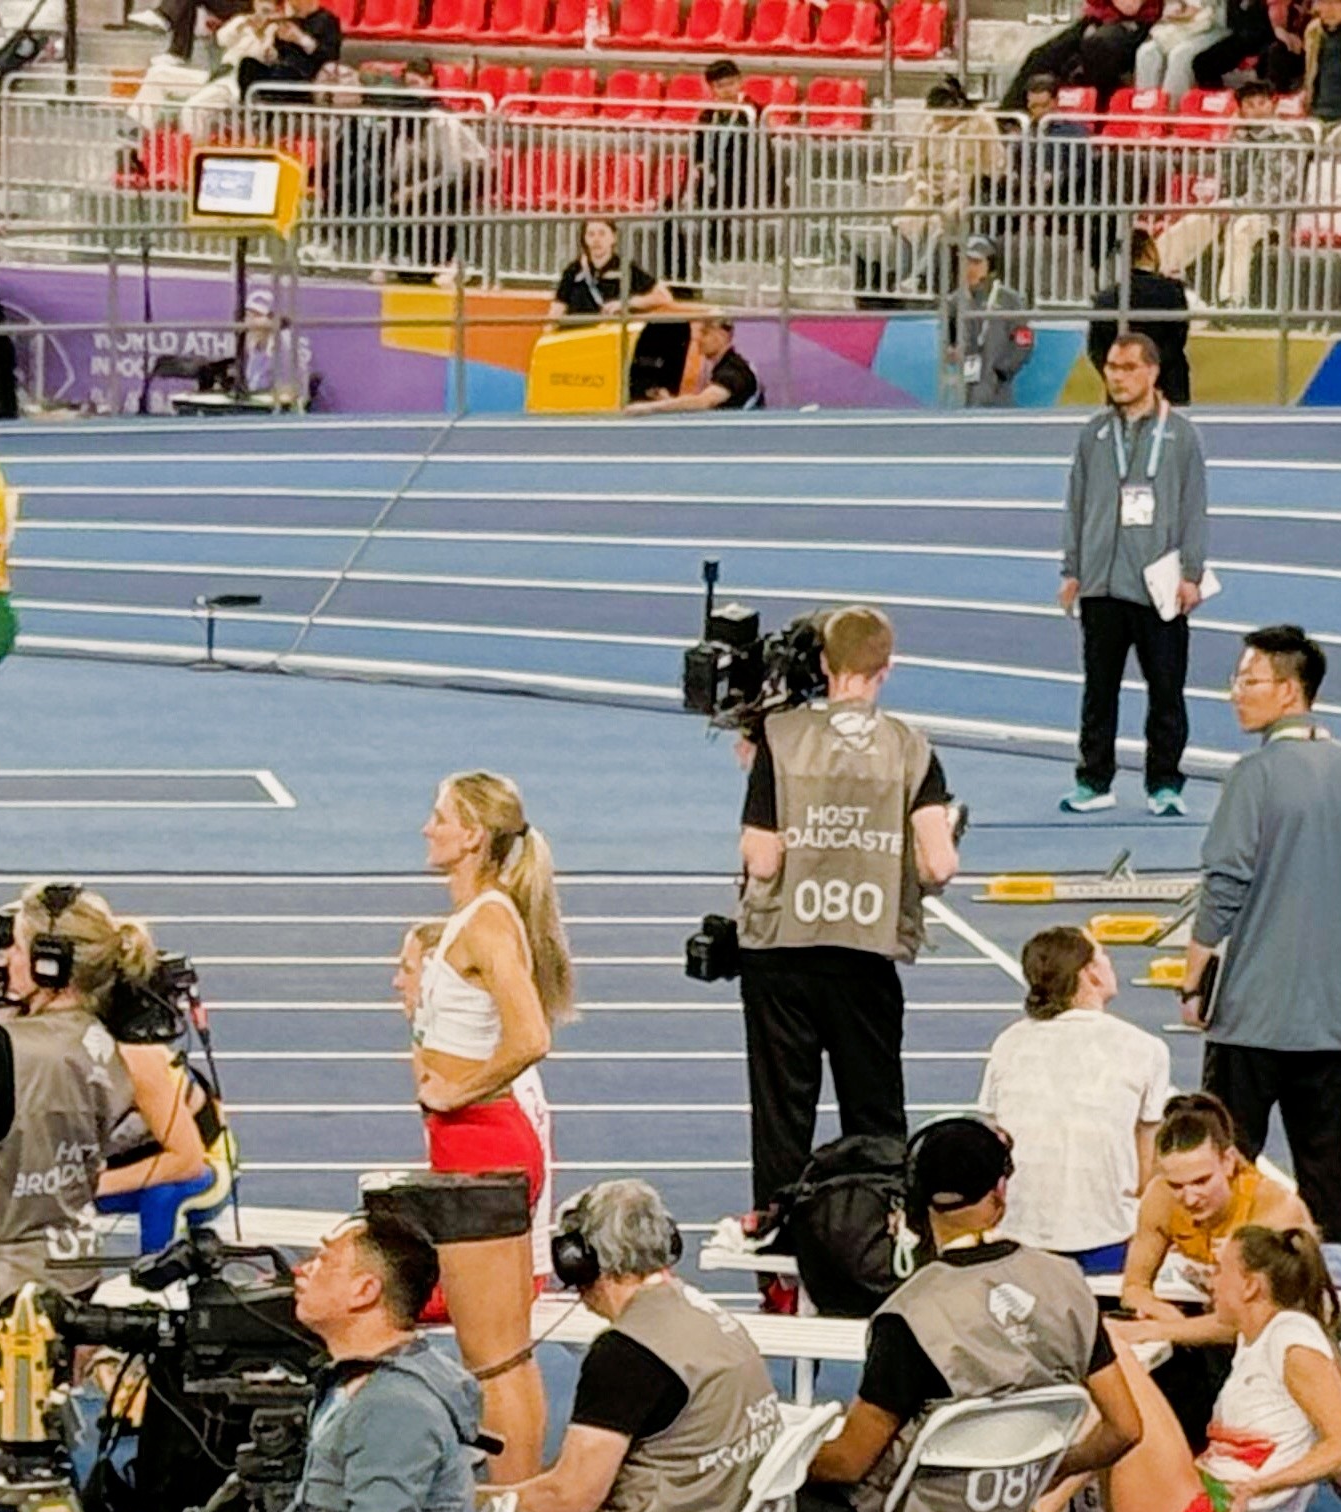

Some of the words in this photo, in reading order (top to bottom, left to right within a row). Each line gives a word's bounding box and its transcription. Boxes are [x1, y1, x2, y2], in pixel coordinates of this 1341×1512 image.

[806, 805, 871, 827] HOST
[785, 827, 904, 856] OADCASTE
[795, 879, 884, 925] 080
